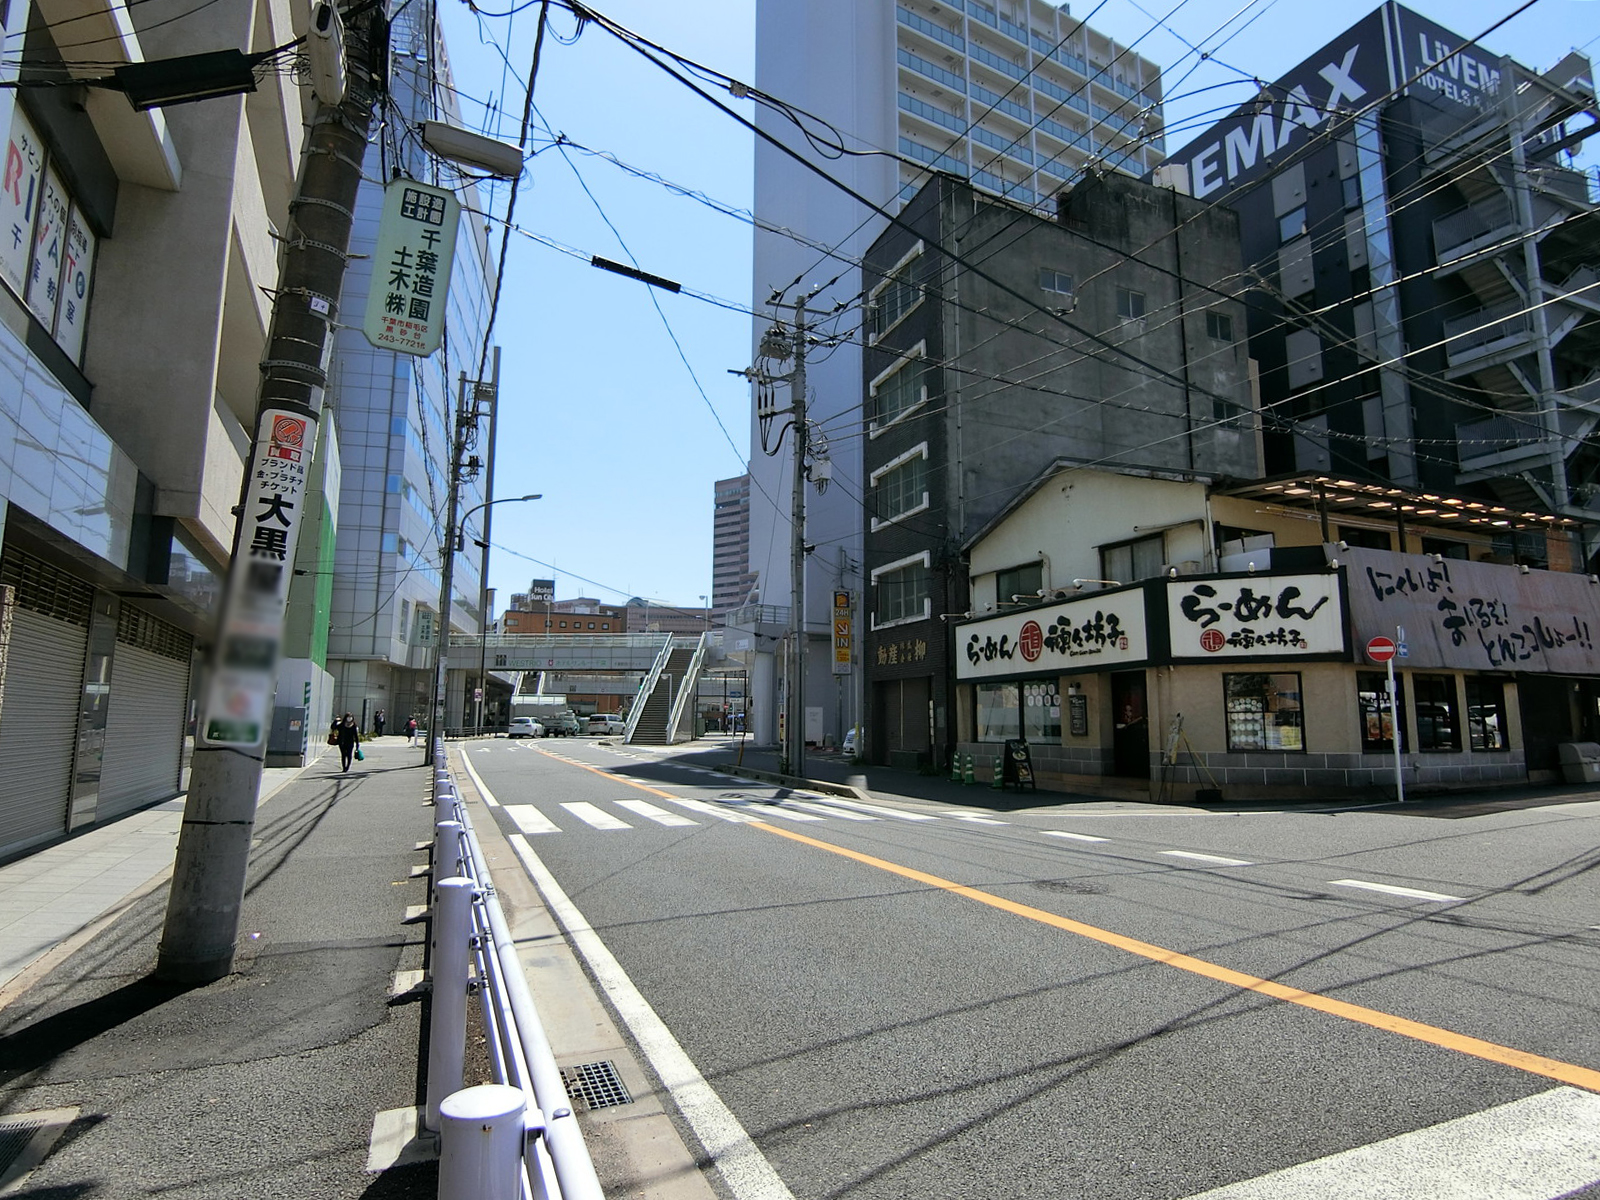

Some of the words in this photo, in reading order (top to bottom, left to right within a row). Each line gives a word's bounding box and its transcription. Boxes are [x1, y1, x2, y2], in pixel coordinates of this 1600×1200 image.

[408, 229, 442, 322] 千葉造園
[261, 458, 304, 475] ブランド品
[260, 480, 298, 495] チケット
[835, 608, 849, 617] 24H
[1180, 584, 1329, 629] らーめん
[837, 637, 849, 648] IN
[967, 633, 1018, 666] らーめん
